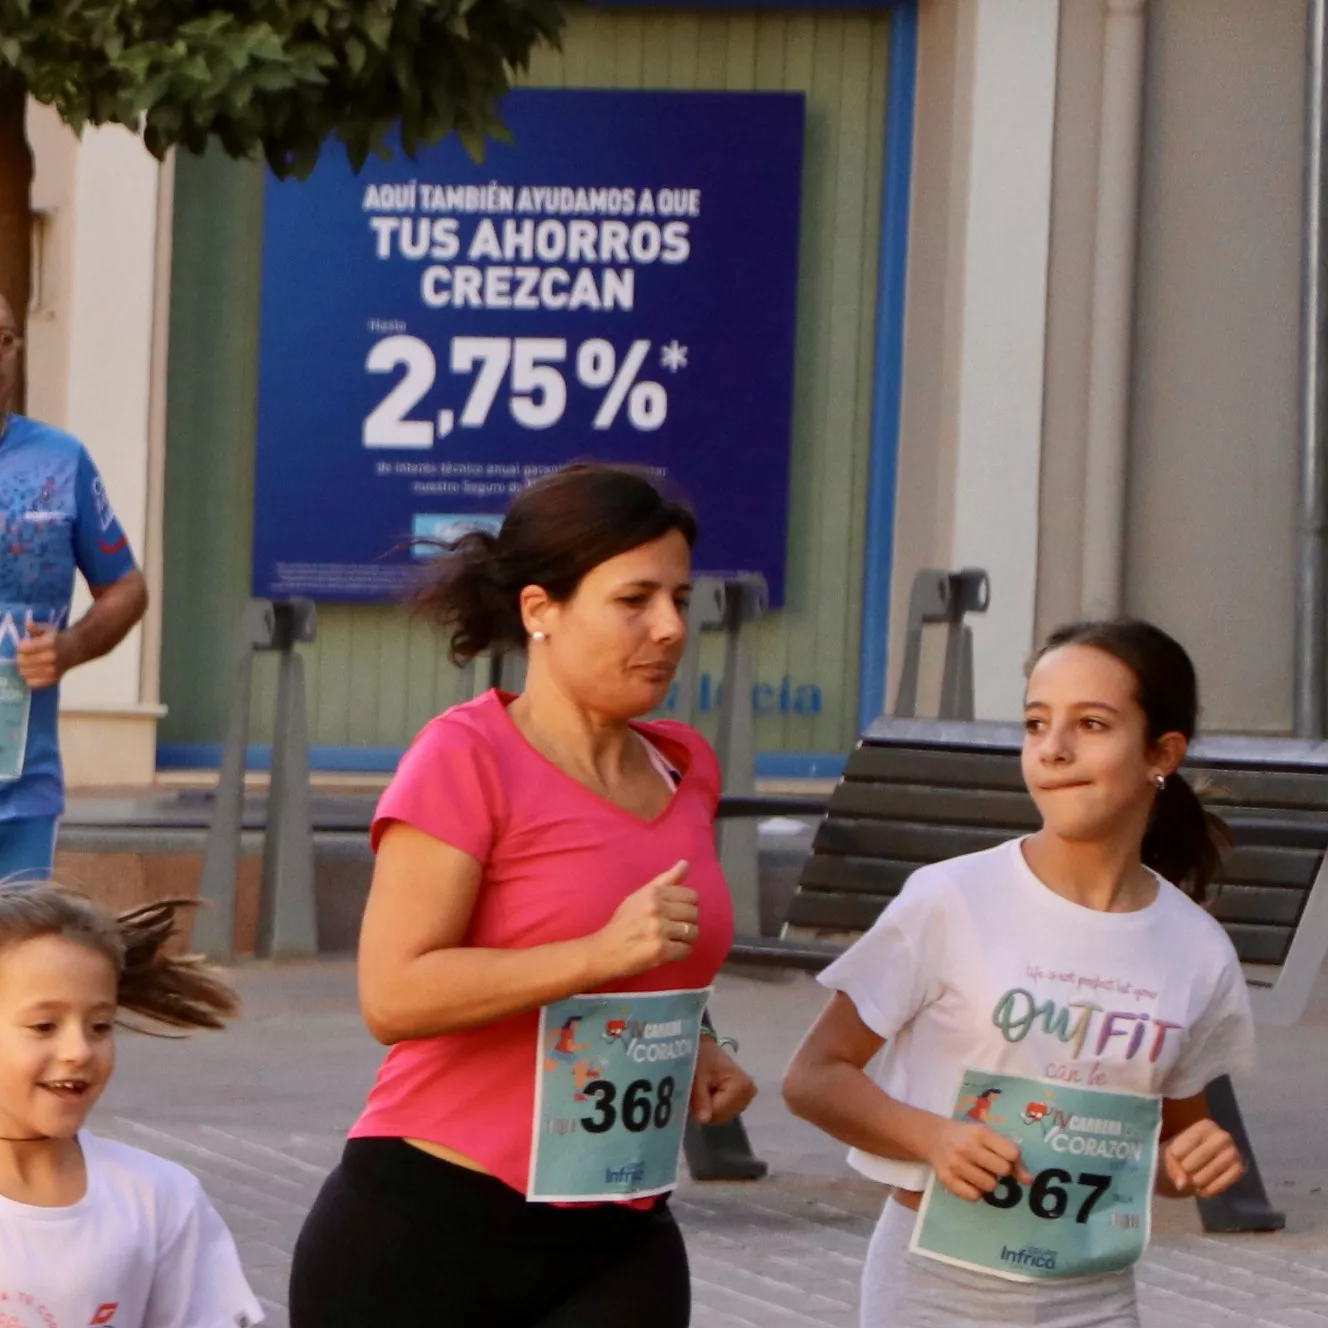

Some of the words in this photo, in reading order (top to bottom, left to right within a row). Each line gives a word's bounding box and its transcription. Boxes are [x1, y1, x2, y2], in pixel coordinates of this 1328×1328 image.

[363, 179, 416, 212] AQUÍ
[420, 180, 514, 214] TAMBIÉN
[516, 187, 635, 217] AYUDAMOS
[637, 188, 655, 217] A
[657, 188, 701, 218] QUE
[369, 217, 460, 260] TUS
[468, 218, 690, 264] AHORROS
[420, 265, 635, 312] CREZCAN
[1046, 1062, 1082, 1083] can
[580, 1076, 675, 1134] 368
